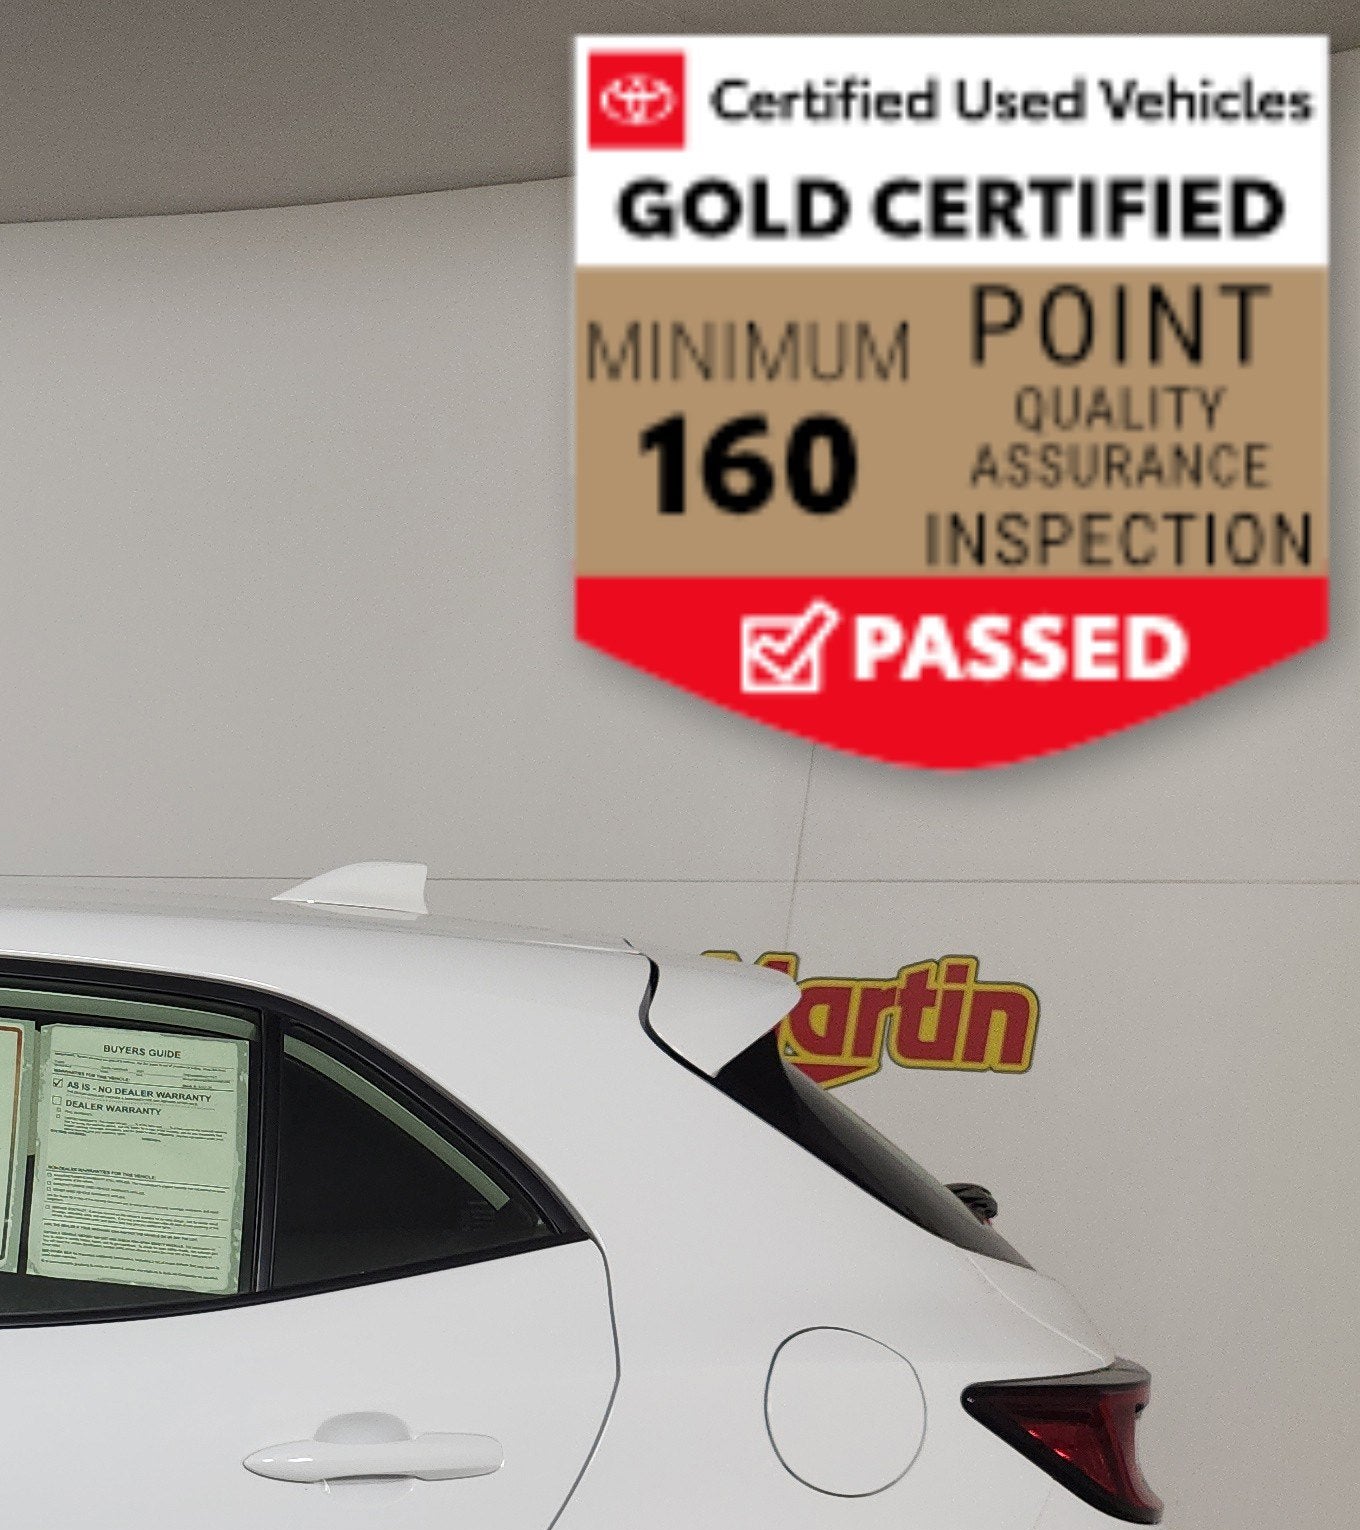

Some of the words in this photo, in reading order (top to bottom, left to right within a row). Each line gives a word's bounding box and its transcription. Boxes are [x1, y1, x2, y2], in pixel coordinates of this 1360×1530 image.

[700, 950, 1040, 1073] artin
[103, 1044, 146, 1057] BUYERS
[148, 1048, 182, 1059] GUIDE
[67, 1081, 80, 1090] AS
[81, 1083, 91, 1092] IS
[98, 1085, 113, 1095] NO
[114, 1087, 154, 1098] DEALER
[156, 1091, 212, 1103] WARRANTY
[65, 1099, 104, 1111] DEALER
[105, 1102, 163, 1116] WARRANTY
